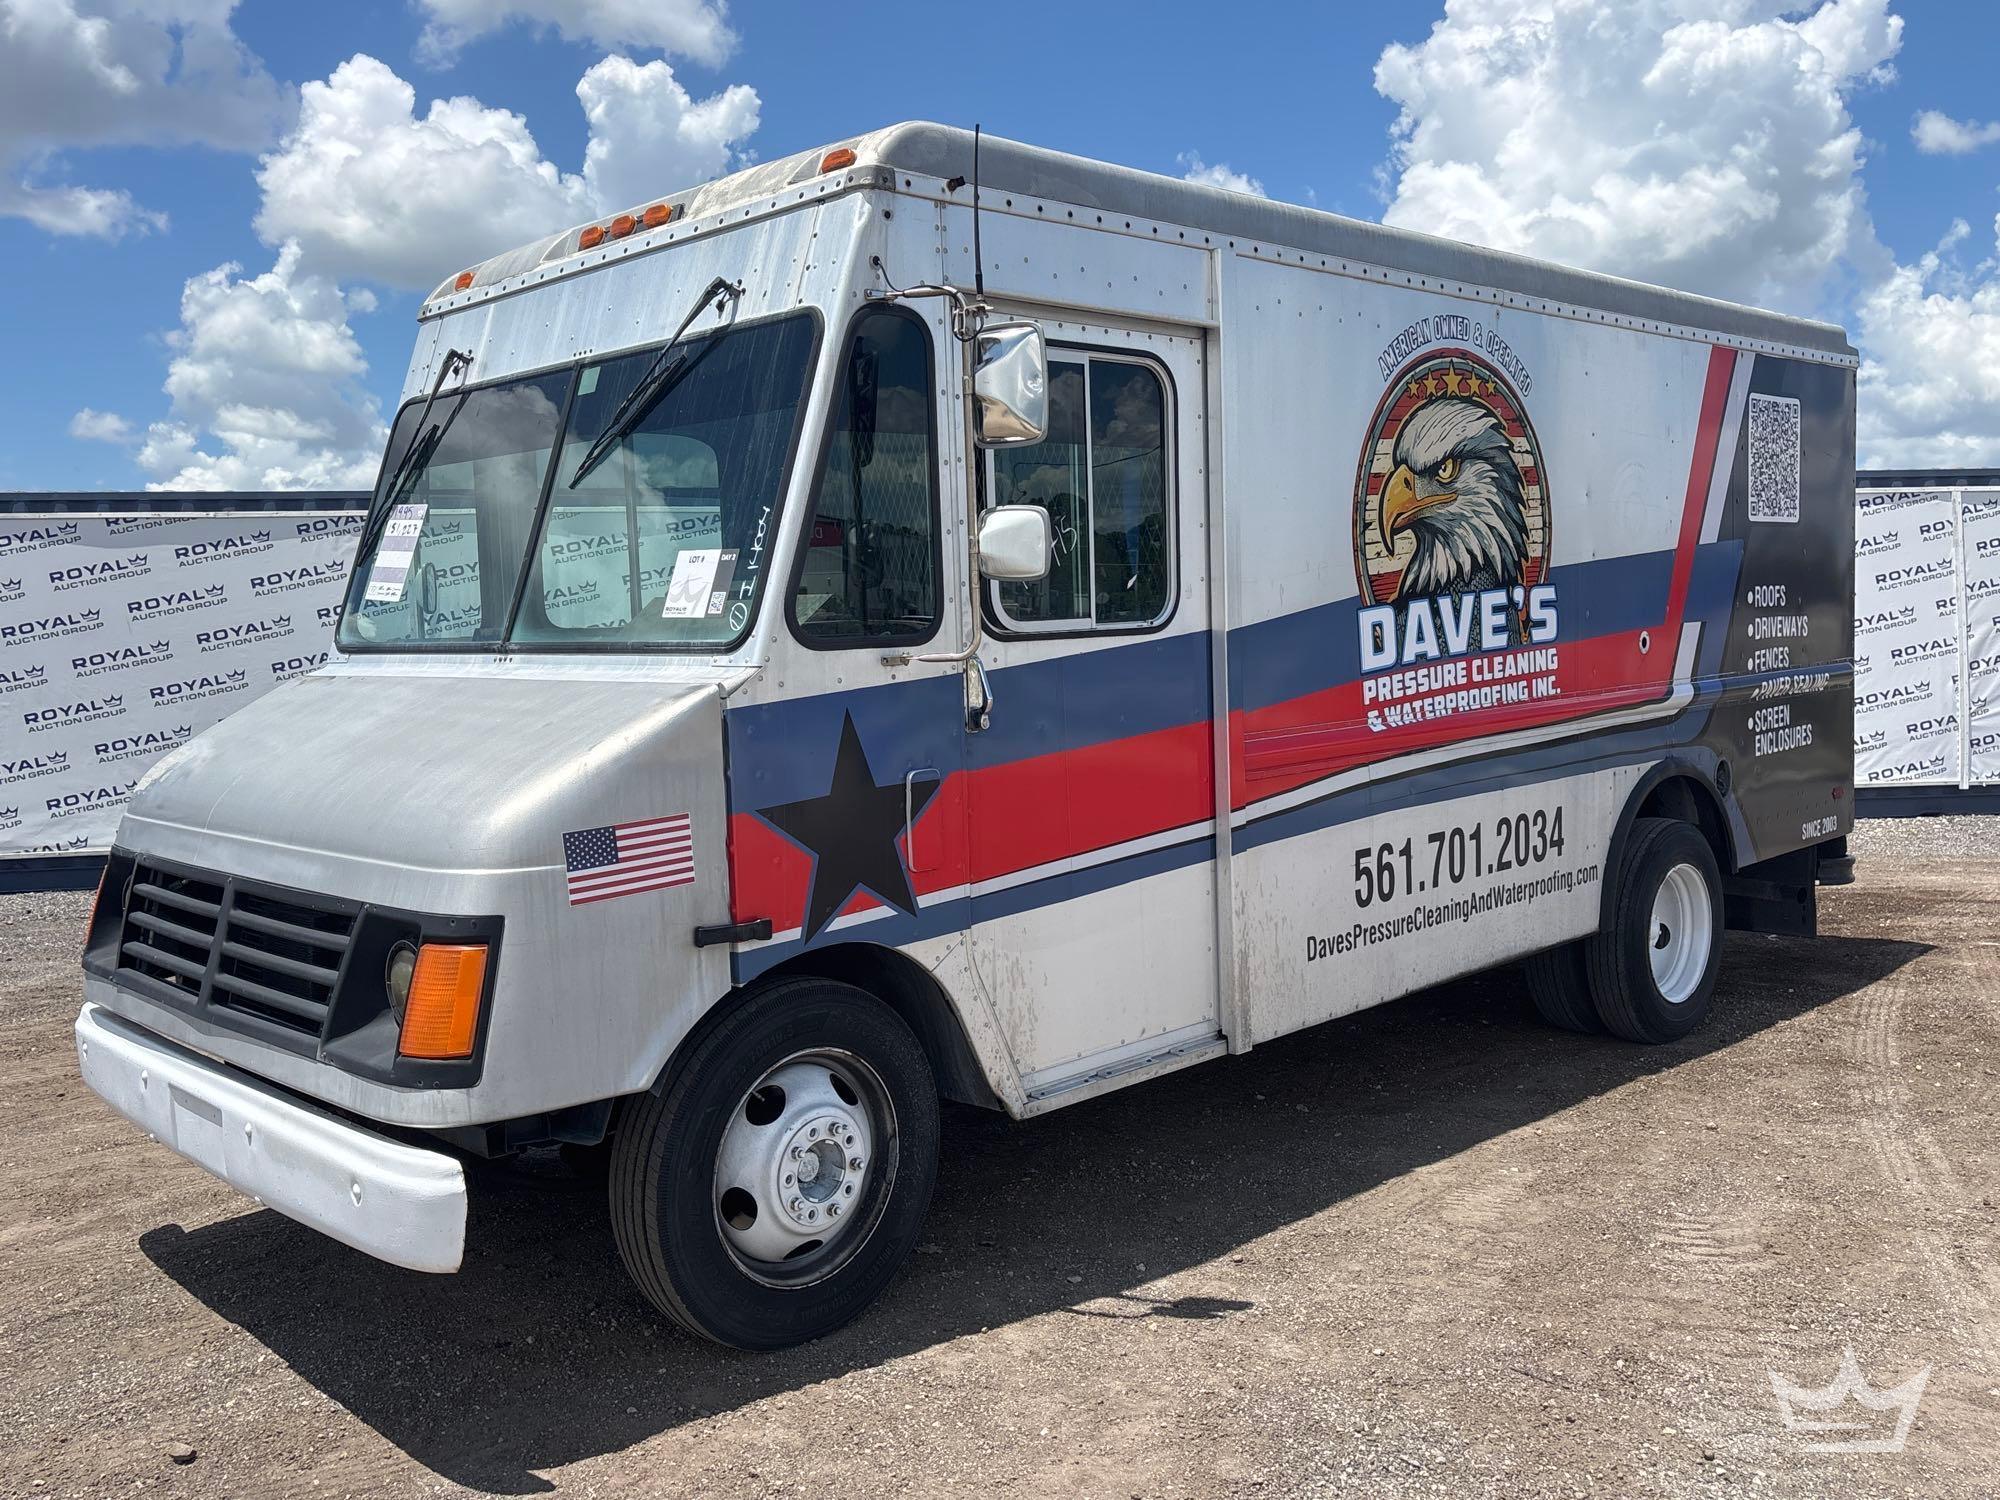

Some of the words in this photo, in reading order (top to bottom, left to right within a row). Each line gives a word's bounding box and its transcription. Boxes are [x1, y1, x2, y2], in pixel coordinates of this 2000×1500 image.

[1378, 318, 1432, 382] AMERICAN
[1433, 315, 1470, 341] OWNED
[1473, 322, 1483, 349] &
[1486, 330, 1533, 397] OPERATED
[1862, 503, 1904, 517] AUCTION
[1906, 495, 1938, 507] GROUP
[110, 520, 162, 535] AUCTION
[666, 514, 721, 533] ROYA
[0, 528, 58, 547] OYAL
[0, 544, 36, 556] CTION
[39, 536, 82, 549] GROUP
[300, 528, 351, 543] AUCTION
[551, 534, 623, 557] ROYAL
[669, 528, 718, 542] AUCTION
[174, 536, 252, 559] ROYAL
[179, 552, 231, 567] AUCTION
[233, 544, 274, 557] GROUP
[554, 550, 604, 565] AUCTION
[1868, 543, 1901, 555] GROUP
[49, 560, 128, 583] ROYAL
[54, 576, 107, 592] AUCTION
[109, 568, 151, 581] GROUP
[251, 565, 325, 589] ROYAL
[435, 562, 478, 580] ROY
[438, 575, 478, 589] AUCTIO
[1875, 563, 1937, 584] ROYAL
[1878, 578, 1920, 592] AUCTION
[1922, 570, 1955, 582] GROUP
[254, 582, 305, 597] AUCTION
[308, 573, 347, 586] GROUP
[544, 586, 579, 600] YAL
[1966, 578, 1999, 592] YAL
[0, 592, 25, 603] OUP
[127, 590, 205, 613] ROYAL
[562, 594, 600, 608] GROUP
[1755, 585, 1786, 608] ROOFS
[131, 606, 184, 622] AUCTION
[187, 597, 228, 611] GROUP
[424, 610, 462, 626] YAL
[1, 615, 81, 638] ROYAL
[5, 631, 59, 647] AUCTION
[62, 622, 104, 636] GROUP
[196, 621, 272, 644] ROYAL
[1358, 585, 1558, 674] DAVE'S
[1755, 616, 1808, 640] DRIVEWAYS
[1884, 617, 1917, 630] GROUP
[200, 638, 251, 653] AUCTION
[254, 628, 294, 642] GROUP
[1891, 638, 1953, 659] ROYAL
[72, 646, 150, 669] ROYAL
[76, 662, 129, 678] AUCTION
[132, 654, 173, 667] GROUP
[271, 653, 328, 673] ROYA
[1755, 647, 1789, 673] FENCES
[1894, 653, 1936, 667] AUCTION
[1938, 647, 1958, 657] GRO
[6, 679, 48, 693] GROUP
[151, 675, 226, 698] ROYAL
[1362, 660, 1467, 705] PRESSURE
[1472, 648, 1558, 683] CLEANING
[154, 691, 206, 707] AUCTION
[209, 682, 249, 696] GROUP
[1367, 710, 1387, 732] &
[1385, 681, 1528, 728] WATERPROOFING
[1532, 676, 1561, 699] INC.
[1856, 701, 1897, 714] AUCTION
[1899, 692, 1933, 705] GROUP
[24, 700, 103, 724] ROYAL
[28, 717, 82, 733] AUCTION
[85, 708, 126, 722] GROUP
[1755, 704, 1790, 732] SCREEN
[1971, 708, 1989, 718] OUP
[1907, 715, 1958, 734] ROYA
[1910, 728, 1951, 742] AUCTION
[95, 731, 173, 755] ROYAL
[1755, 724, 1812, 757] ENCLOSURES
[1, 757, 47, 774] YAL
[99, 747, 151, 764] AUCTION
[0, 774, 26, 785] TION
[28, 764, 71, 778] GROUP
[1868, 761, 1929, 781] ROYAL
[1914, 767, 1947, 780] GROUP
[46, 786, 125, 810] ROYAL
[50, 802, 104, 819] AUCTION
[1802, 818, 1821, 840] SINCE
[1823, 815, 1837, 833] 2003
[1355, 807, 1564, 908] 561.701.2034
[1306, 864, 1598, 962] DavesPressureCleaningAndWaterproofing.com
